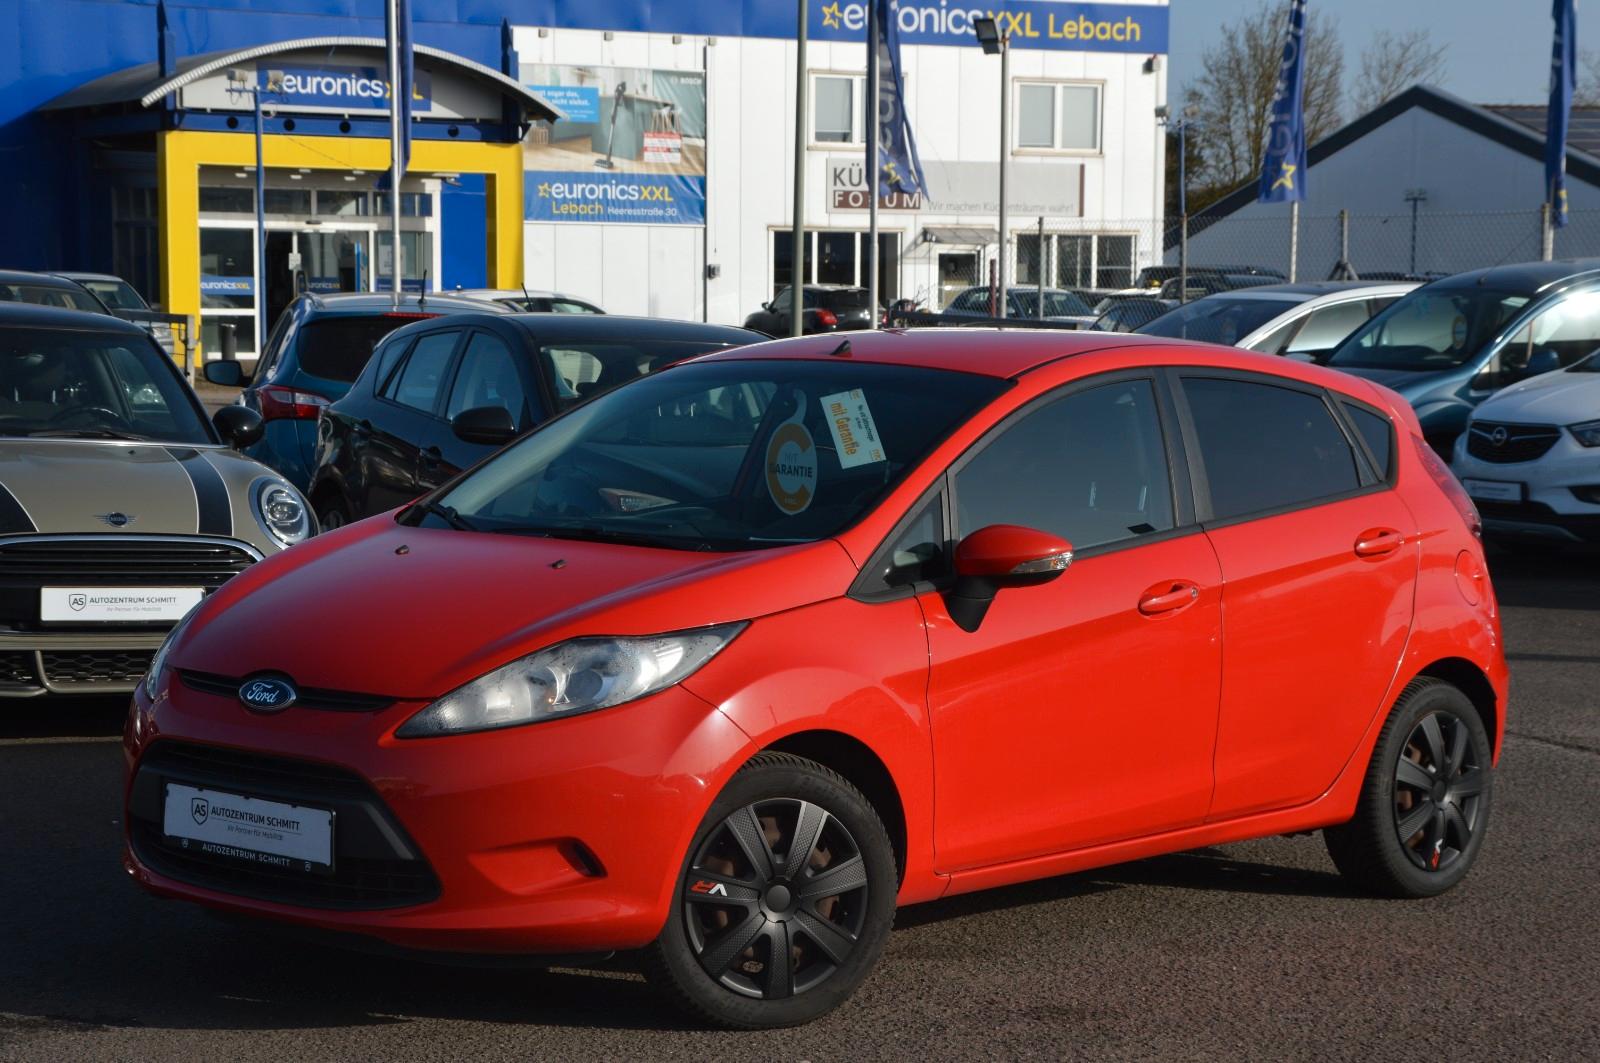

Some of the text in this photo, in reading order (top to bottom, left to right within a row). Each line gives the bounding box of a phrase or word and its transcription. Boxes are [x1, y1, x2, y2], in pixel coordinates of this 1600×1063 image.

[1048, 13, 1140, 41] Lebach
[552, 201, 604, 215] Lebach
[665, 207, 677, 217] 30
[834, 191, 921, 208] FOUM
[71, 597, 84, 606] AS
[146, 596, 176, 604] SCHMITT
[247, 682, 280, 703] Ford
[194, 803, 300, 832] AS AUTOZENTRUM SCHMITT
[202, 843, 290, 867] AUTOZENTRUM SCHMITT
